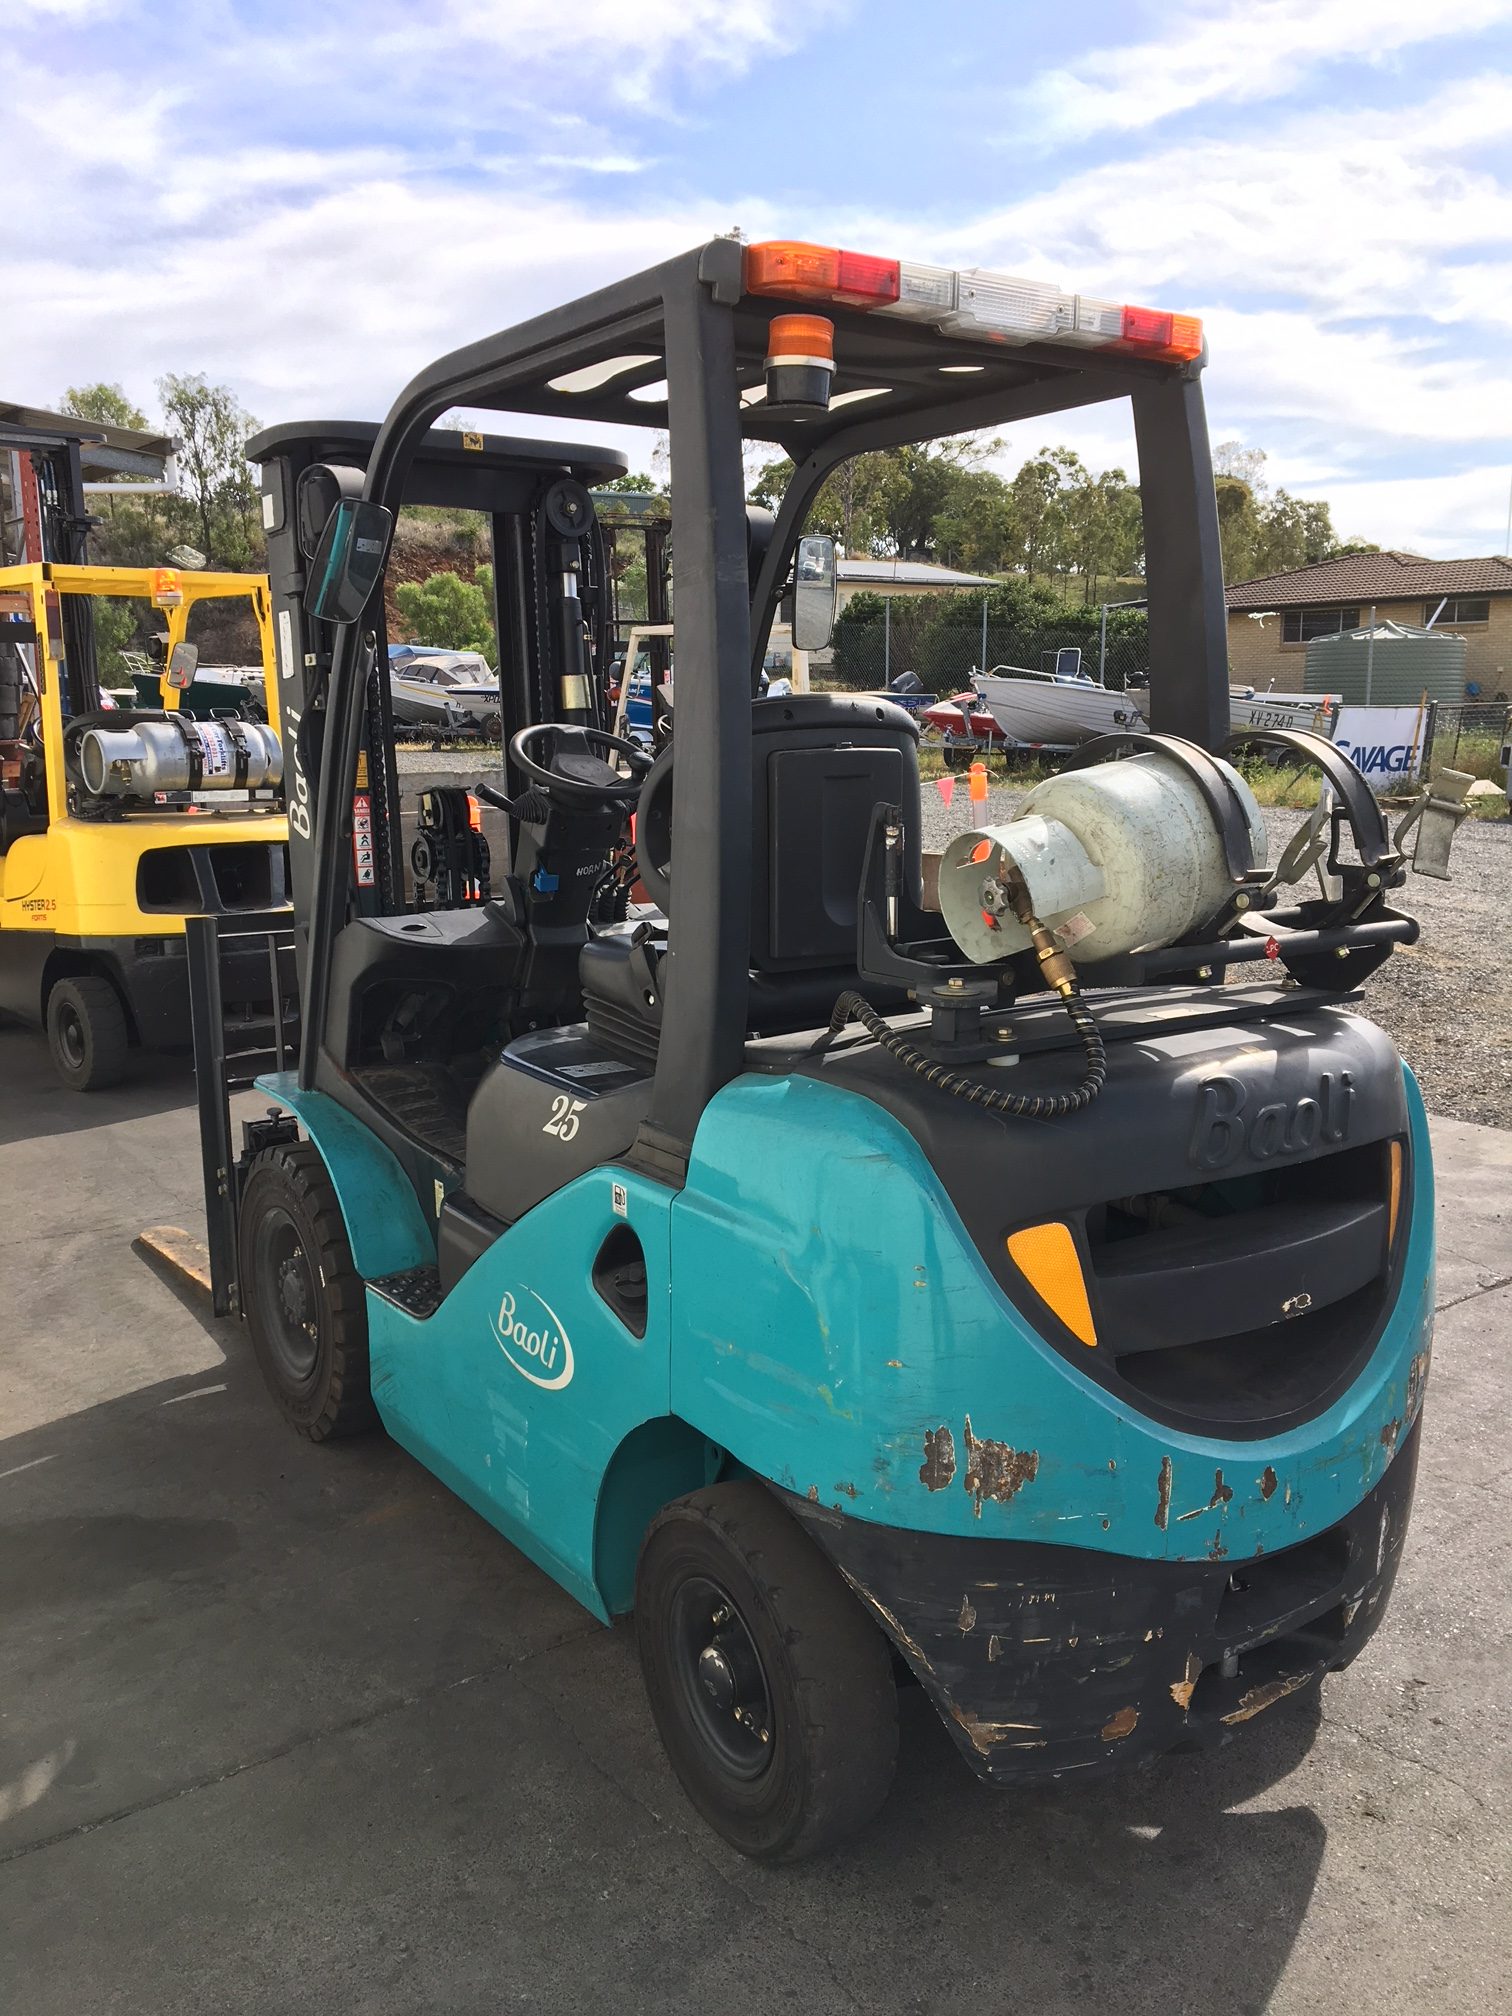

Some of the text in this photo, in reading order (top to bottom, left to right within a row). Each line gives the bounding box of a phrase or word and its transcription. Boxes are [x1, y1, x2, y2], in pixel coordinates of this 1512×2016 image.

[576, 861, 601, 876] HORN
[21, 899, 45, 911] HYSTER
[542, 1095, 588, 1141] 25
[1191, 1069, 1357, 1169] Baoli
[498, 1291, 558, 1369] Baoli
